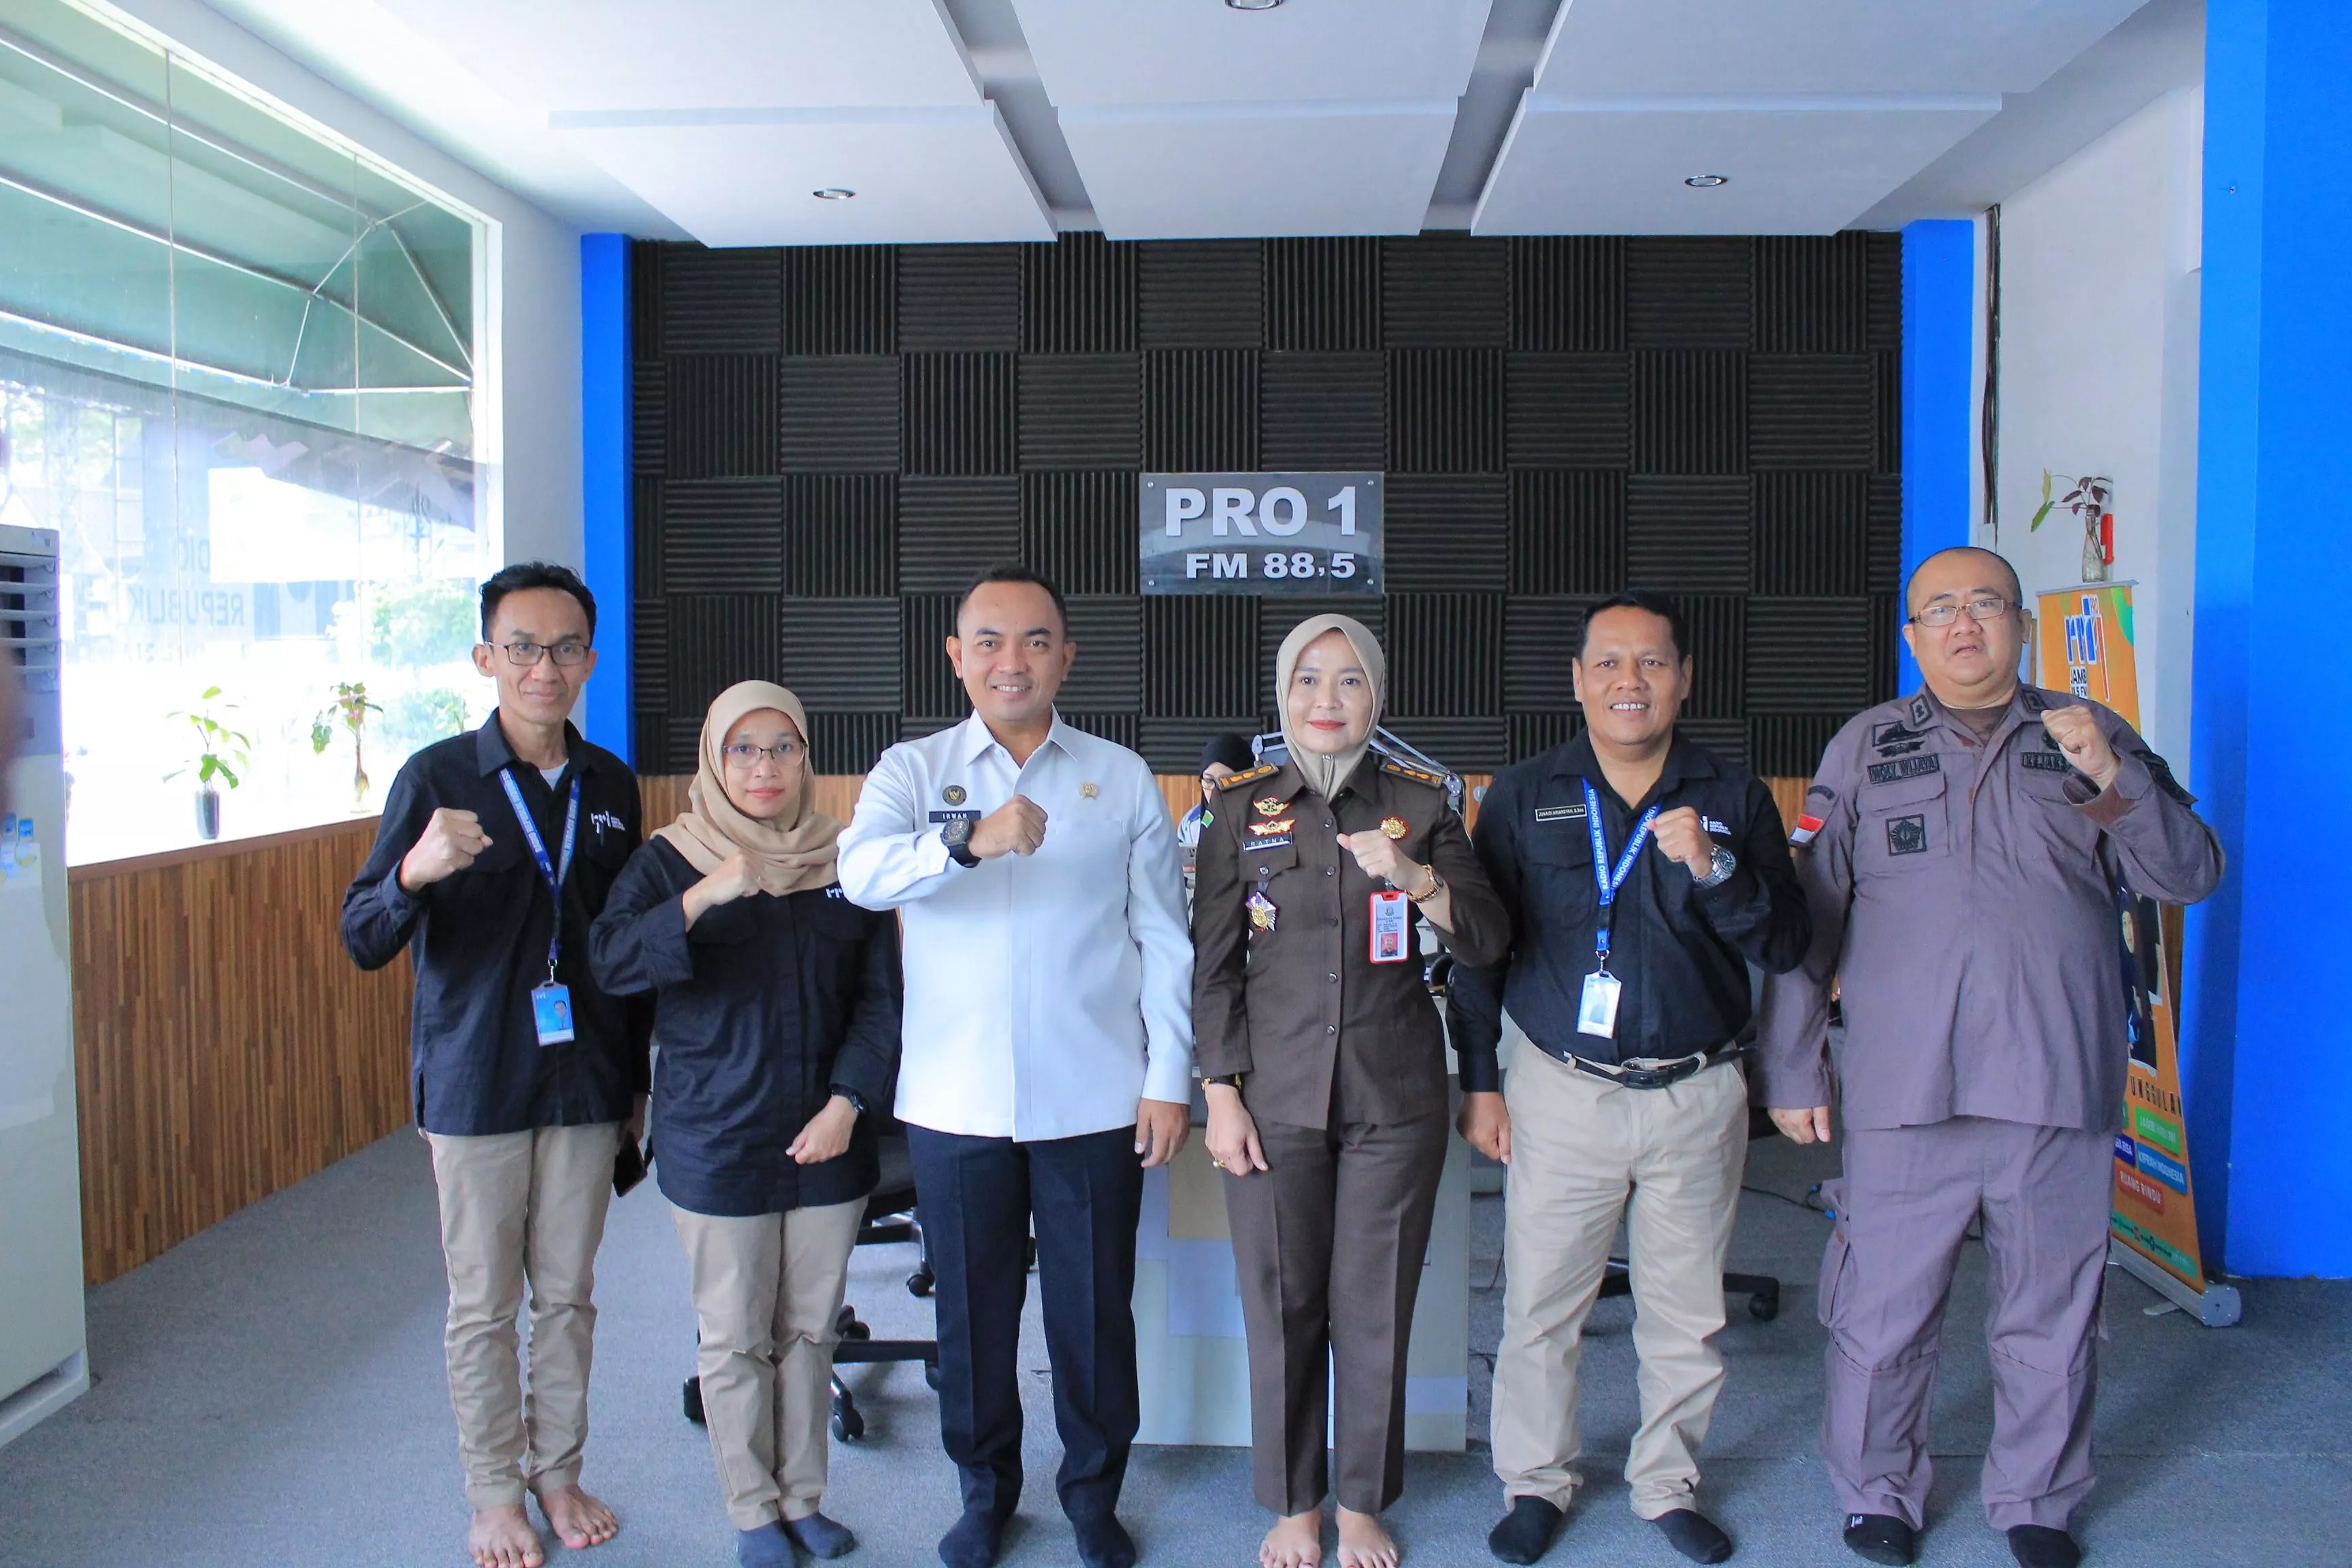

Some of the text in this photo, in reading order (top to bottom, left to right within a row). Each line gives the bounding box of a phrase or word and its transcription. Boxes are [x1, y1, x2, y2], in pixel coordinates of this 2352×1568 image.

[1165, 486, 1356, 536] PRO 1
[1186, 553, 1247, 578] FM
[1645, 806, 1657, 821] DIO
[1250, 836, 1284, 847] RATNA
[1588, 788, 1608, 889] RADIO REPUBLIK INDONESIA
[1611, 855, 1633, 890] INDONESI
